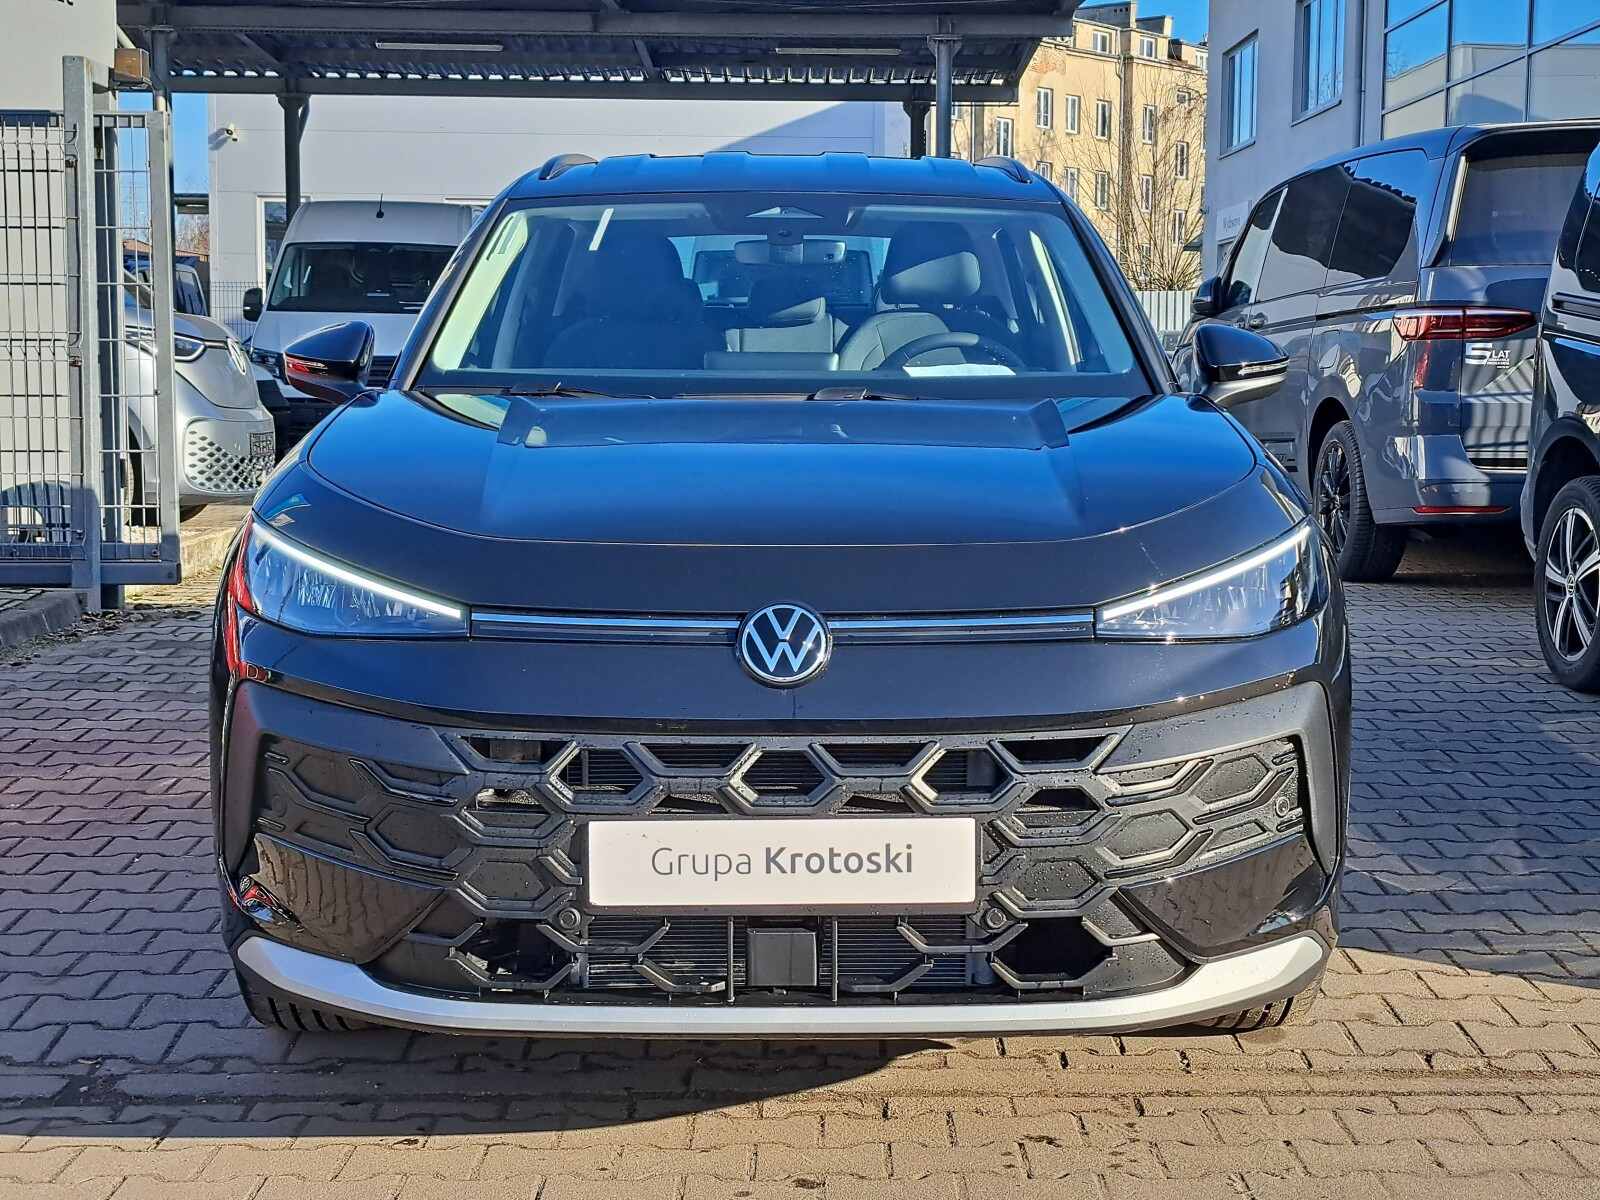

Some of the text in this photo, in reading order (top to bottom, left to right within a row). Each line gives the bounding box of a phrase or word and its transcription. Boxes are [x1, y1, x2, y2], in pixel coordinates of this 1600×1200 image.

[1465, 342, 1511, 365] 5 LAT
[741, 604, 827, 682] VW
[651, 843, 913, 881] Grupa Krotoski
